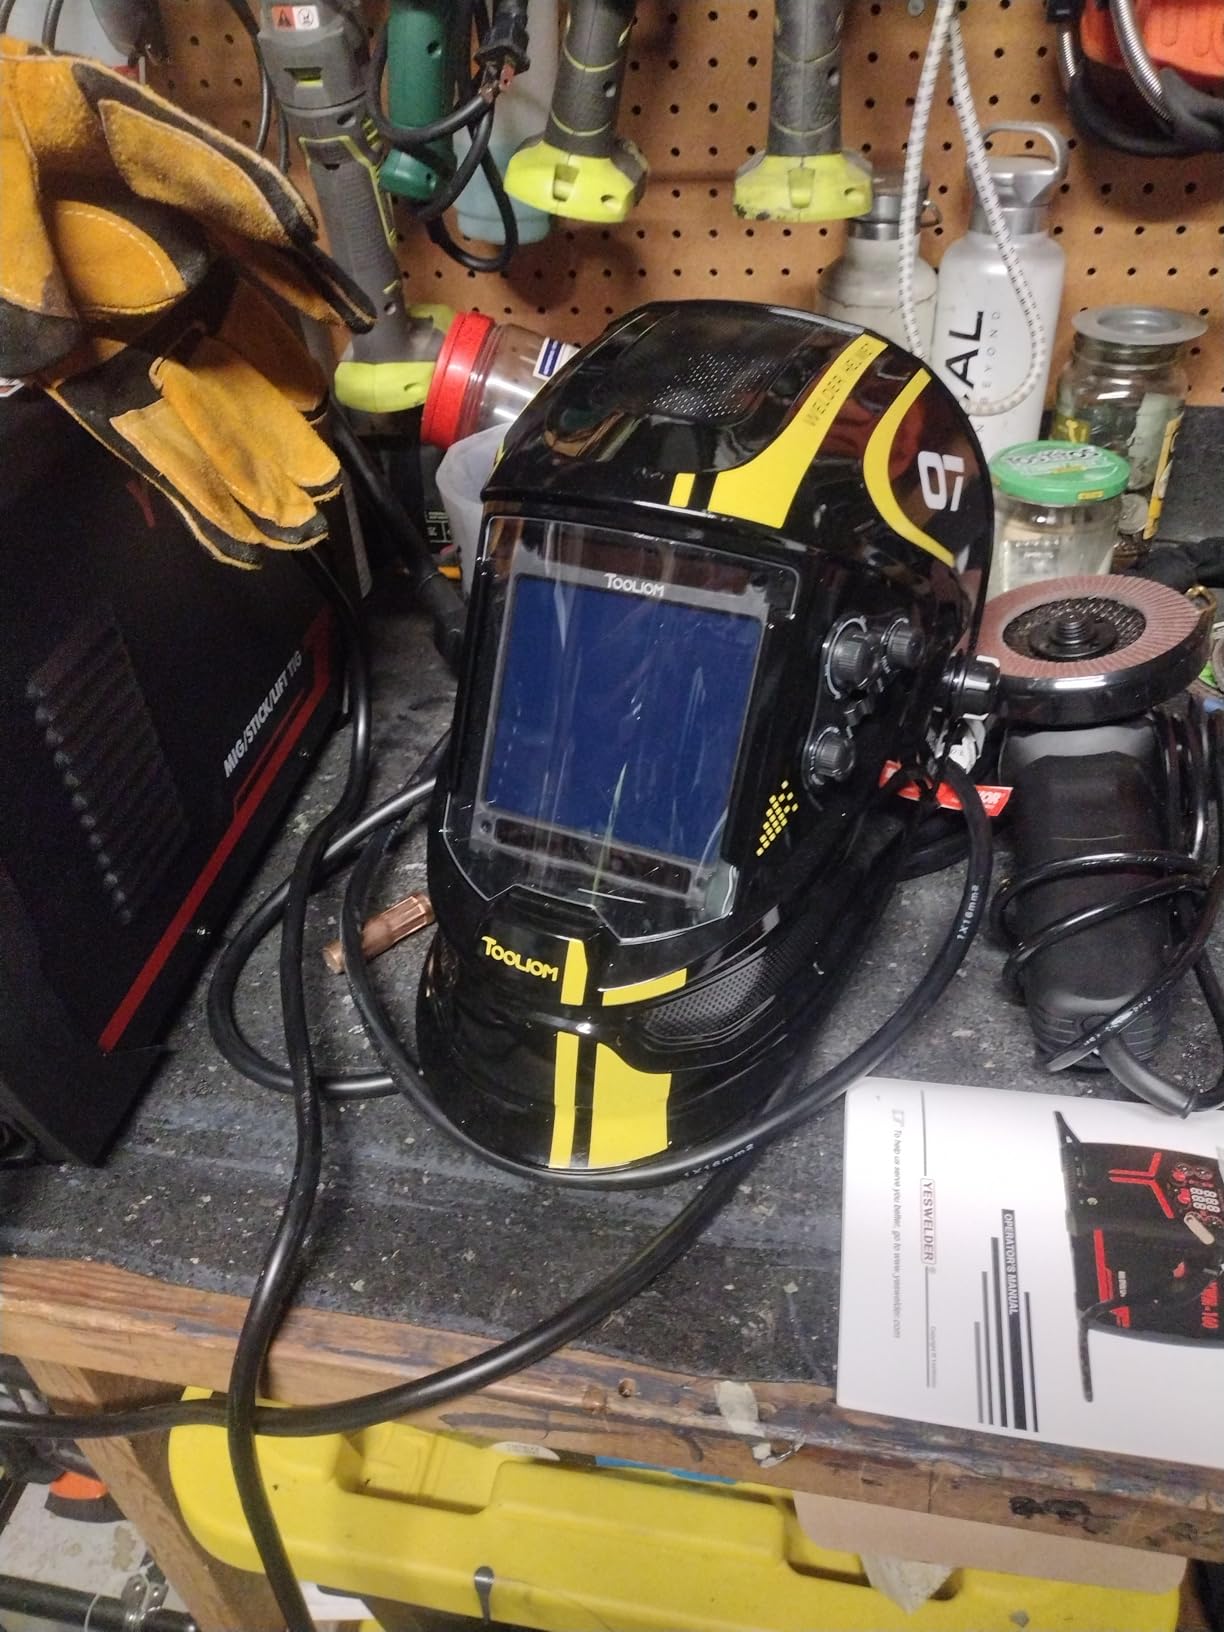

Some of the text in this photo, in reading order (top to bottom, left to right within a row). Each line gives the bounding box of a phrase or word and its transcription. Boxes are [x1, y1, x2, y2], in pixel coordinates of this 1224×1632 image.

[803, 374, 842, 427] WELDER
[223, 650, 303, 778] MIG/STICK/LIFT TIG
[481, 935, 559, 982] TOOLIOM
[892, 1139, 902, 1154] help
[891, 1187, 901, 1203] you
[893, 1166, 901, 1187] serve
[922, 1182, 934, 1261] YESWELDER
[1004, 1213, 1019, 1315] OPERATOR'S MANUAL
